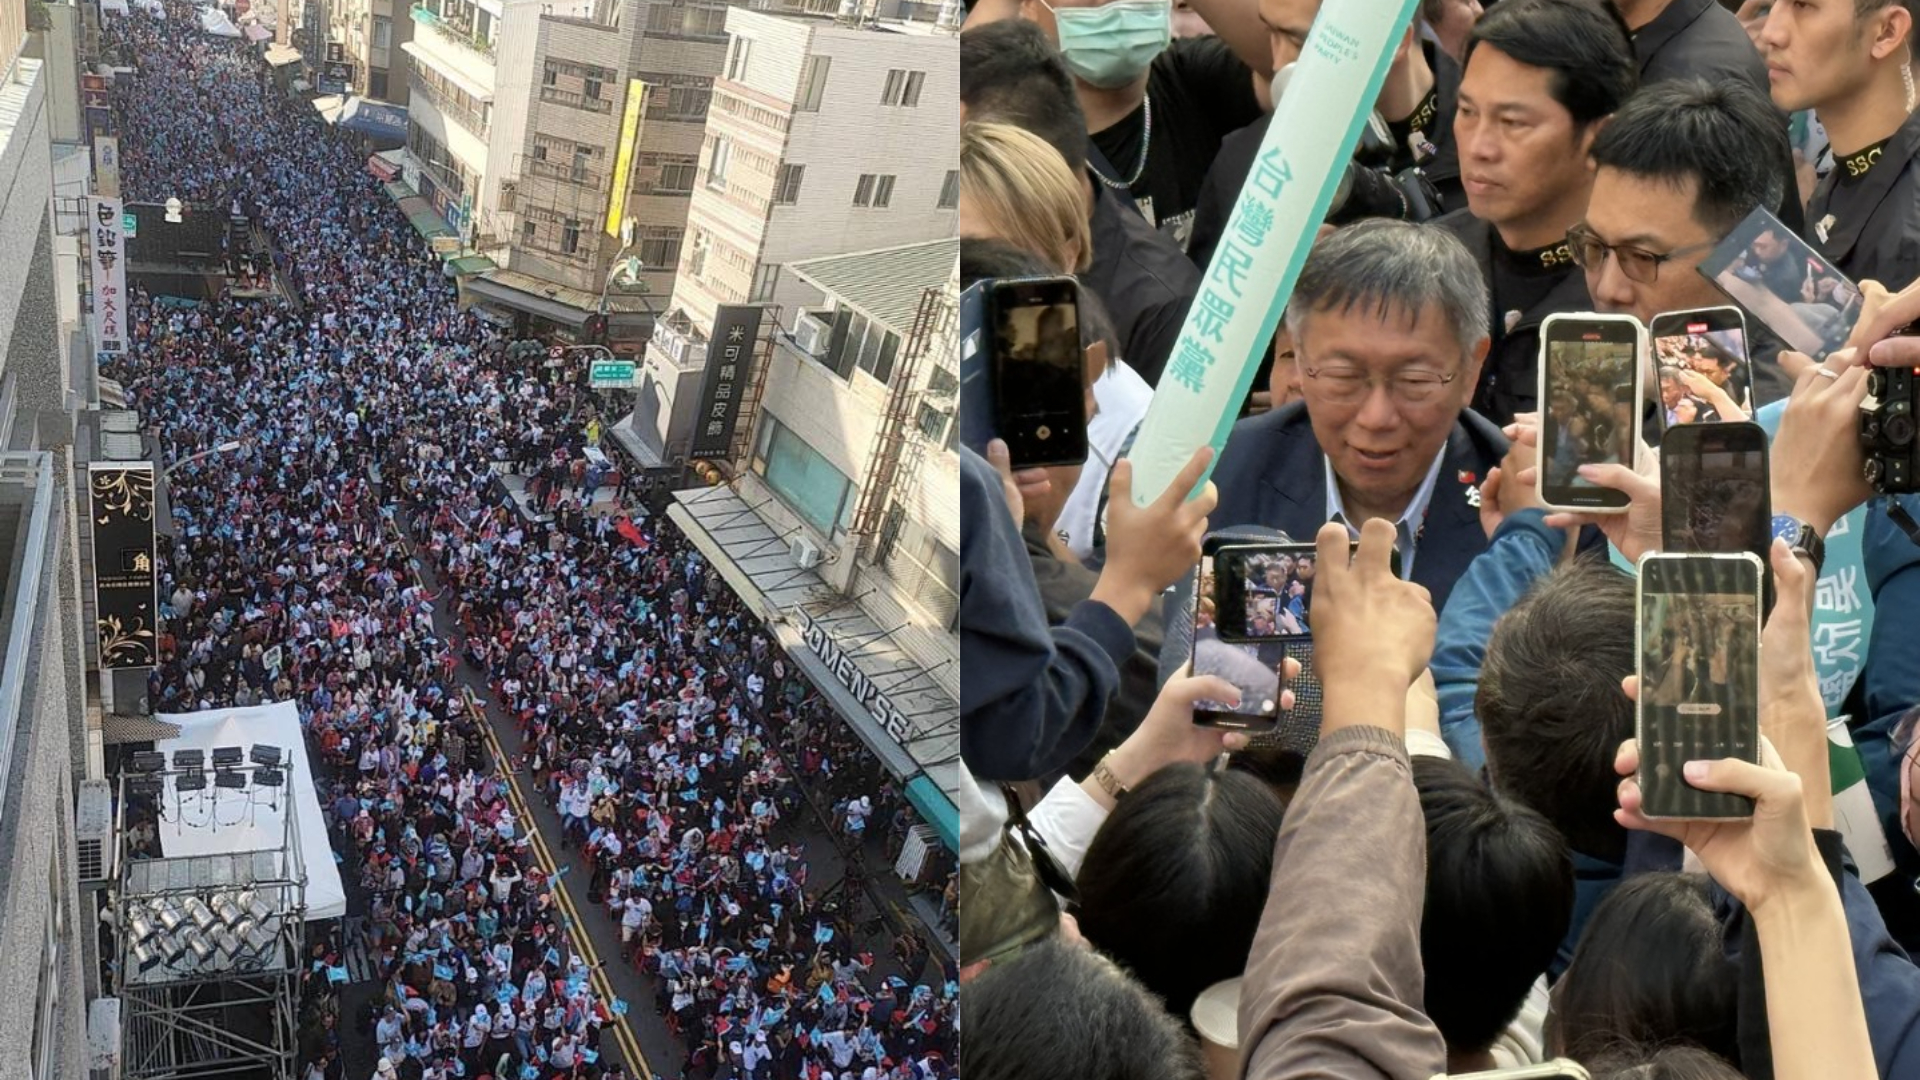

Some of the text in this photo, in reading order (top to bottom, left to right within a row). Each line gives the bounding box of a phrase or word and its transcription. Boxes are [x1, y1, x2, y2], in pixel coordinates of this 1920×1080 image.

[1169, 146, 1294, 394] 台灣民眾黨
[706, 326, 745, 436] 米可精品皮飾
